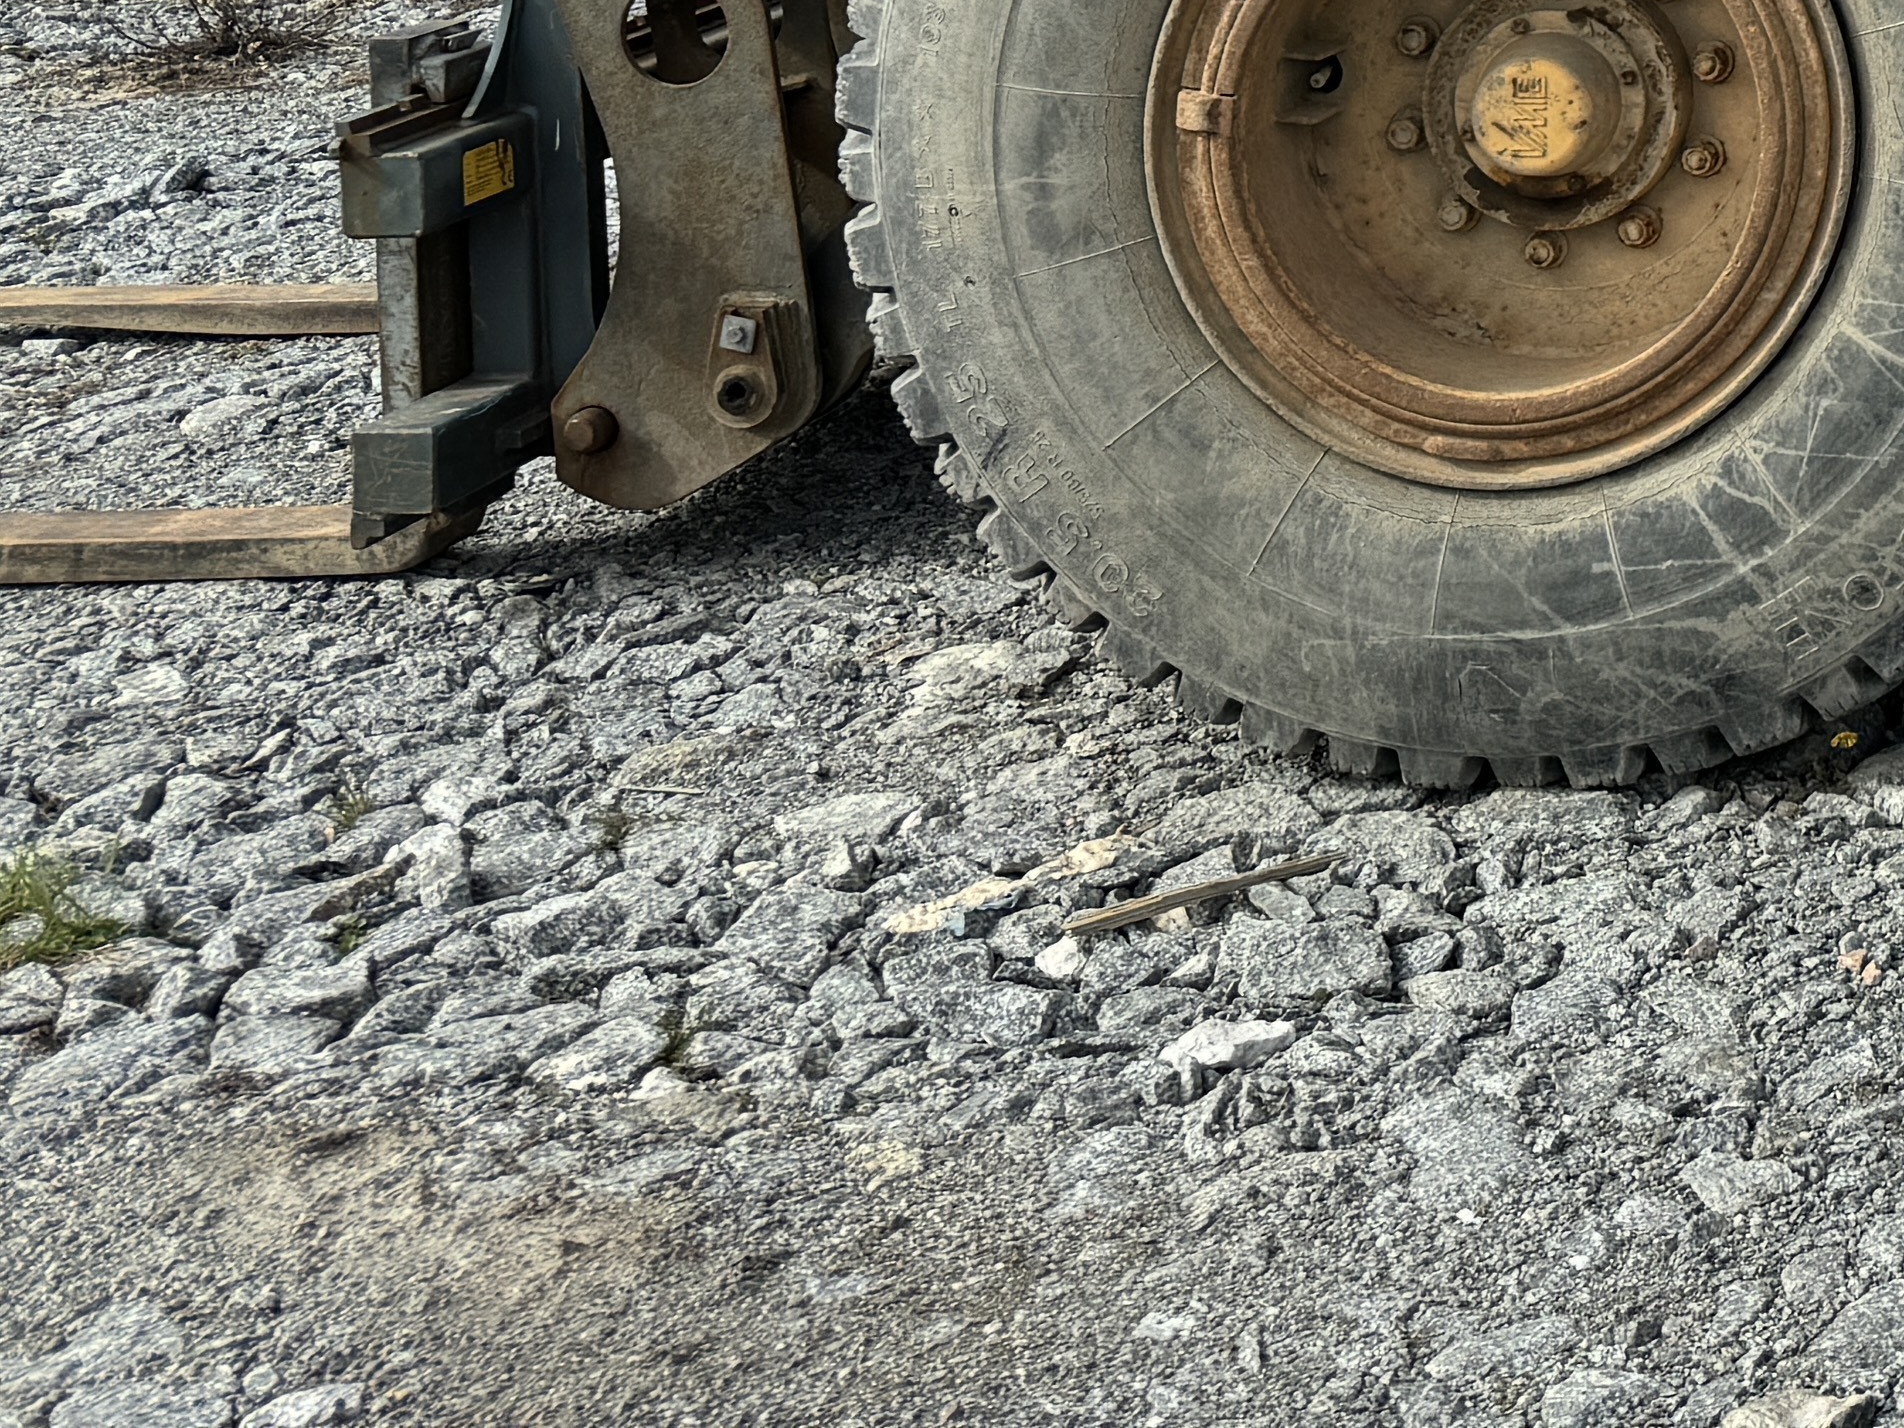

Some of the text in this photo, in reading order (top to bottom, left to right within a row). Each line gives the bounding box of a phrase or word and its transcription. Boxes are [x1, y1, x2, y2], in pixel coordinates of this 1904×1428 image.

[944, 362, 1010, 437] 25
[1003, 451, 1049, 503] R
[1045, 511, 1164, 617] 20.5
